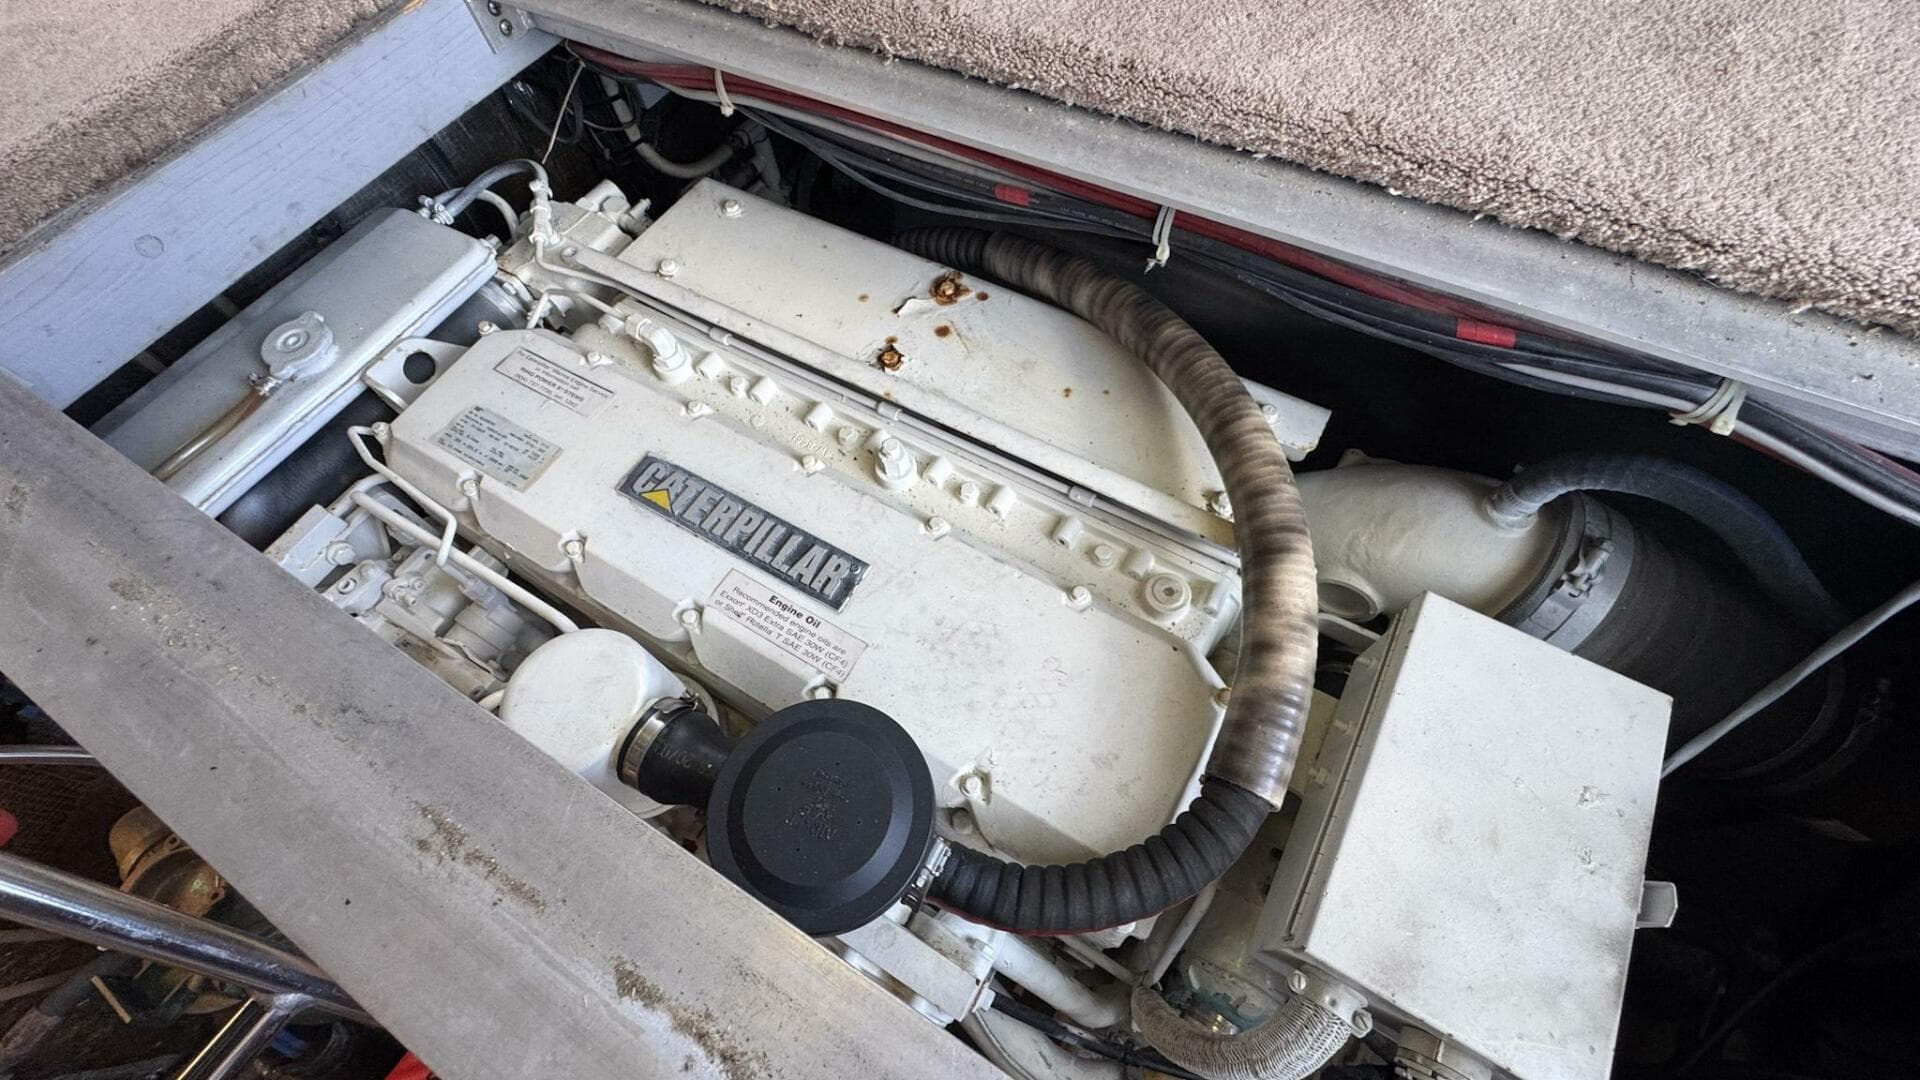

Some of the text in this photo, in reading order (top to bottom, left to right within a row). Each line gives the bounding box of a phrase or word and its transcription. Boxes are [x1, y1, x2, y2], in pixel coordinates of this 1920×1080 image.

[732, 586, 846, 654] Recommended engine oils are
[769, 595, 821, 628] Engine Oil
[763, 615, 784, 631] Extra
[785, 628, 805, 642] SAE
[804, 639, 825, 653] 30W
[824, 651, 848, 668] (CF4)
[782, 638, 802, 652] SAE
[802, 649, 822, 662] 30W
[821, 660, 845, 677] (CF4)
